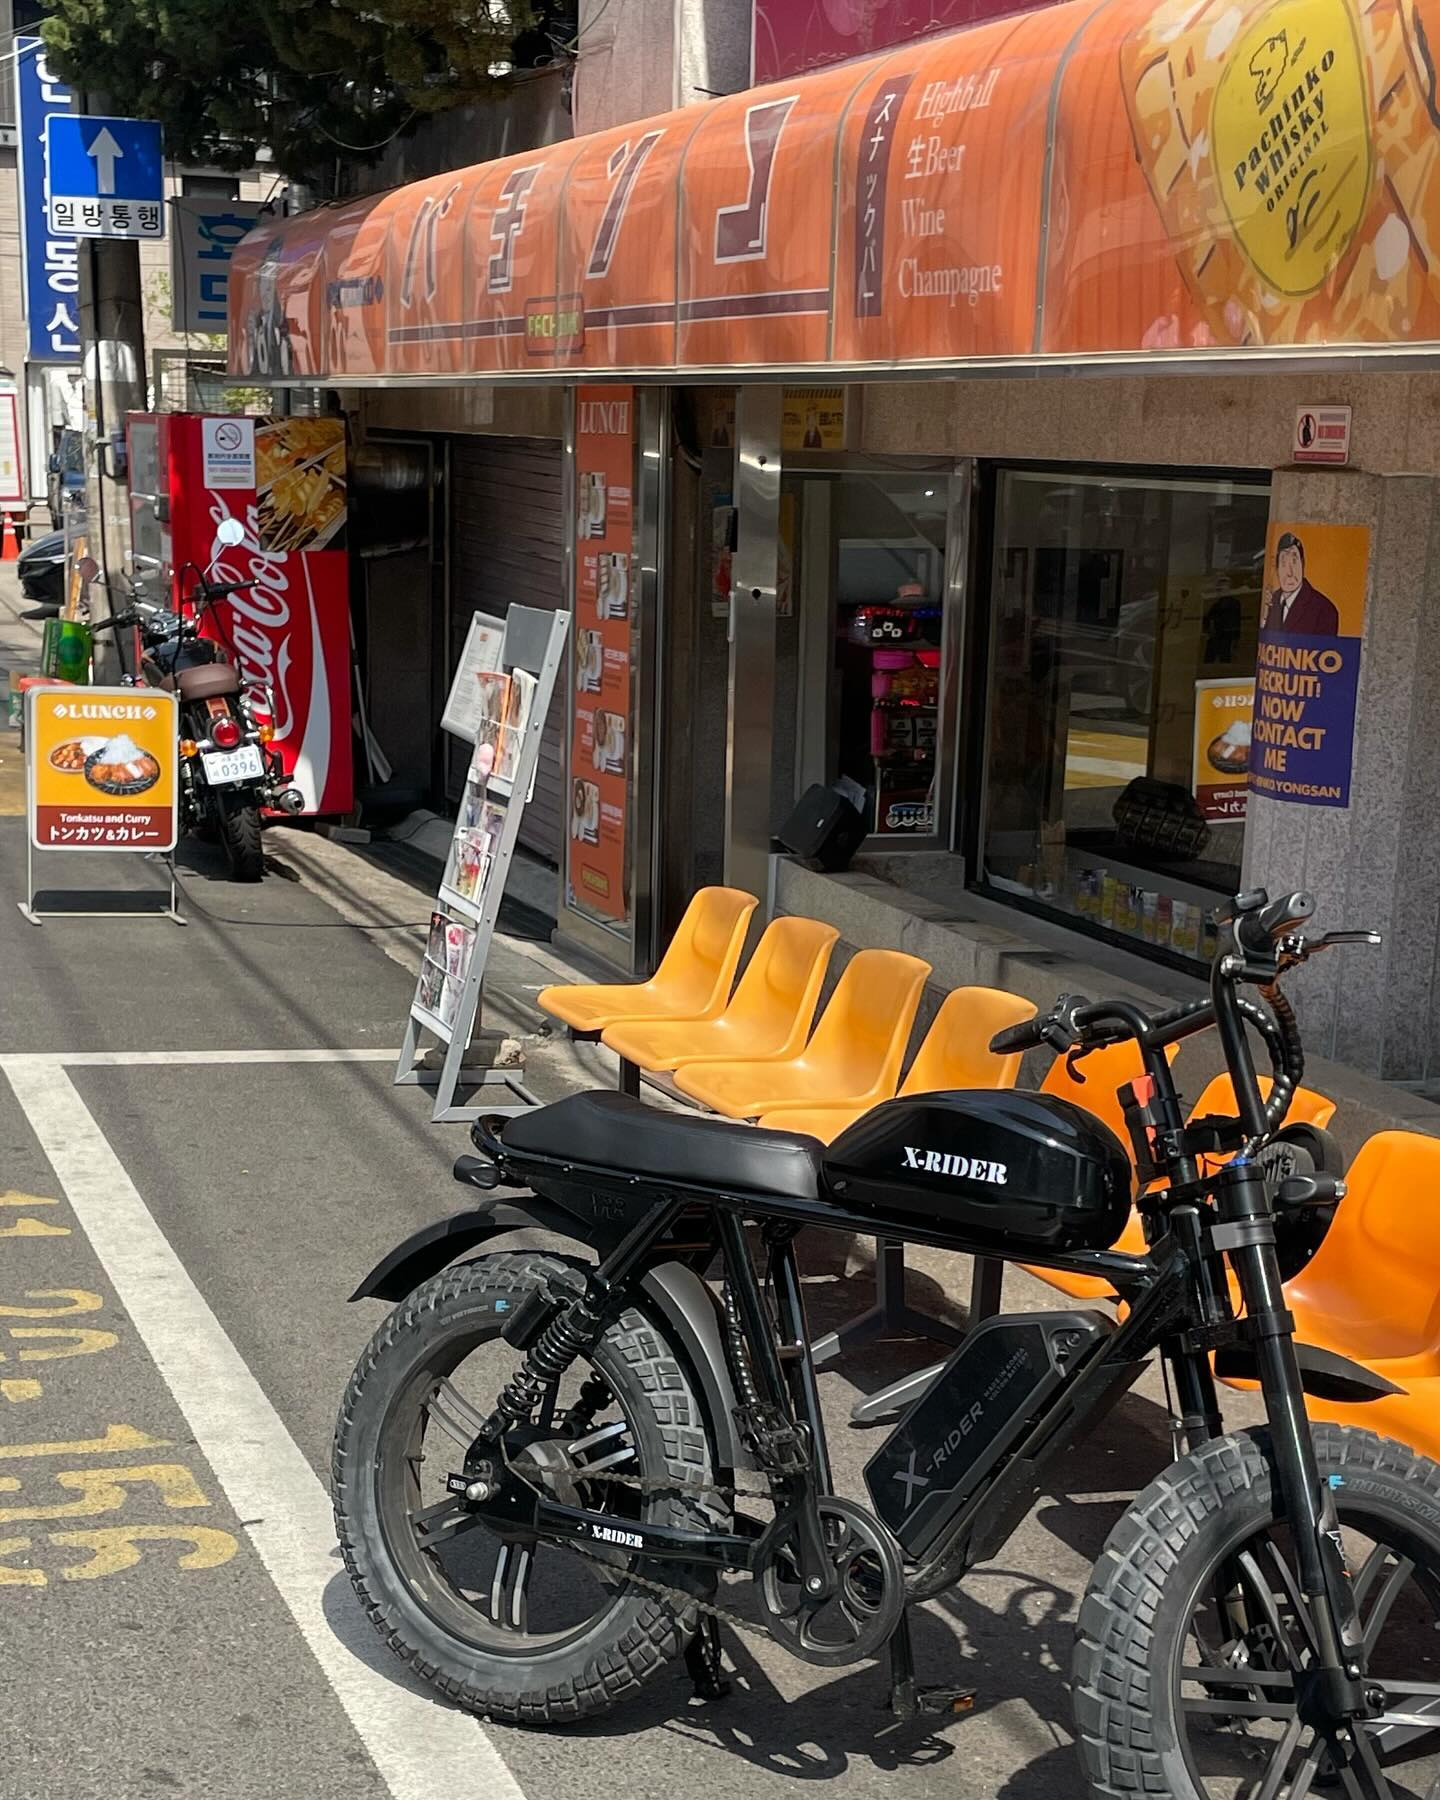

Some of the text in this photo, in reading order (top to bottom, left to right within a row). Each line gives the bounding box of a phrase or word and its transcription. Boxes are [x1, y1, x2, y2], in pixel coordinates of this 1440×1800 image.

[914, 68, 1002, 128] Highball
[1266, 120, 1329, 212] ORIGINAL
[54, 203, 159, 232] 일방통행
[901, 198, 945, 239] Wine
[898, 258, 1002, 307] Champagne
[579, 401, 629, 434] LUNCH
[69, 704, 141, 720] LUNCH
[1261, 695, 1306, 722] NOW
[1253, 719, 1326, 750] CONTACT
[222, 760, 257, 777] 0396
[1264, 748, 1287, 772] ME
[60, 813, 151, 825] Tonkatsu and Curry
[901, 1147, 1008, 1185] X-RIDER
[893, 1399, 985, 1509] X-RIDER
[592, 1525, 644, 1549] X-RIDER
